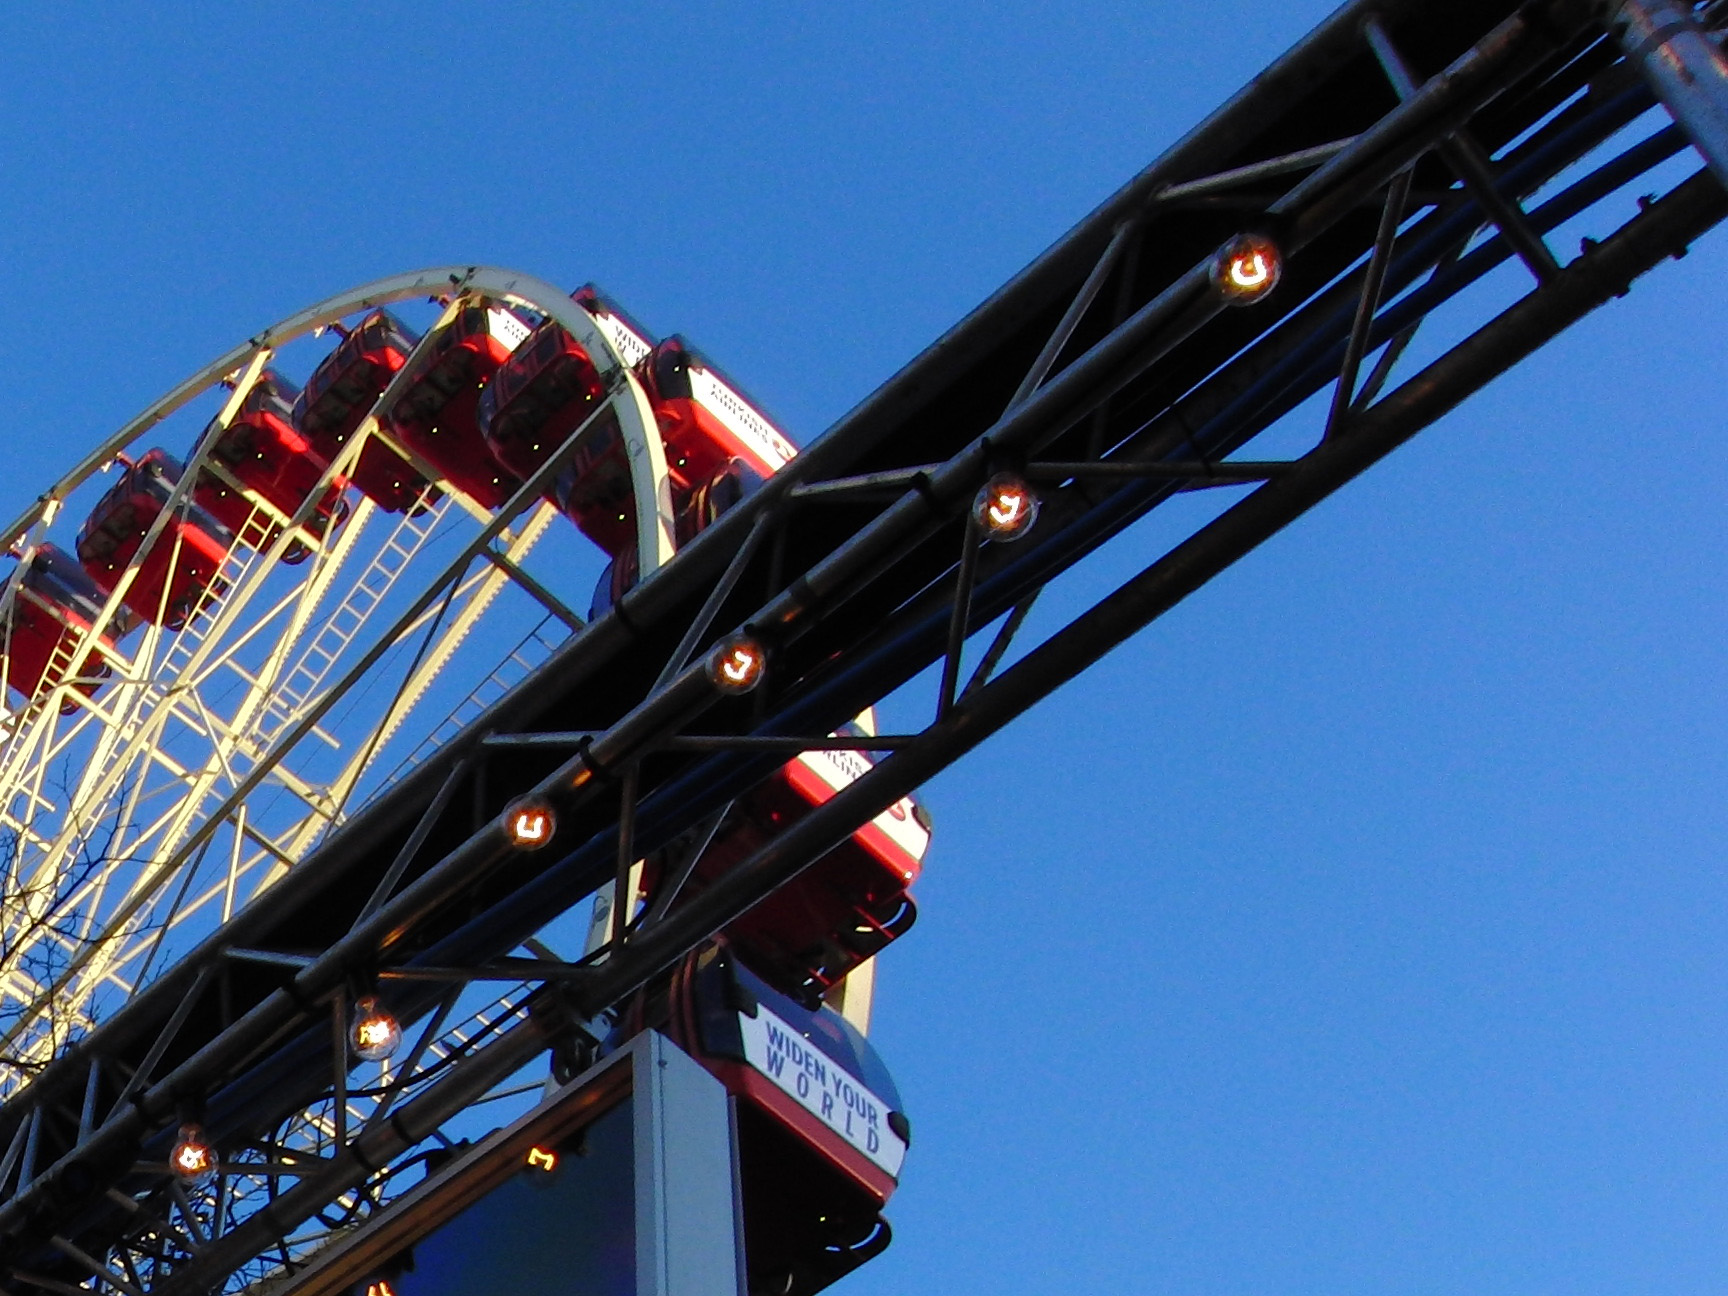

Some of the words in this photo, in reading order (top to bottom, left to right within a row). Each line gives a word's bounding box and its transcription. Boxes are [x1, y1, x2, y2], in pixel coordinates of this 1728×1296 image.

[766, 1021, 827, 1087] WIDEN
[831, 1072, 879, 1130] YOUR
[766, 1045, 880, 1154] WORLD
